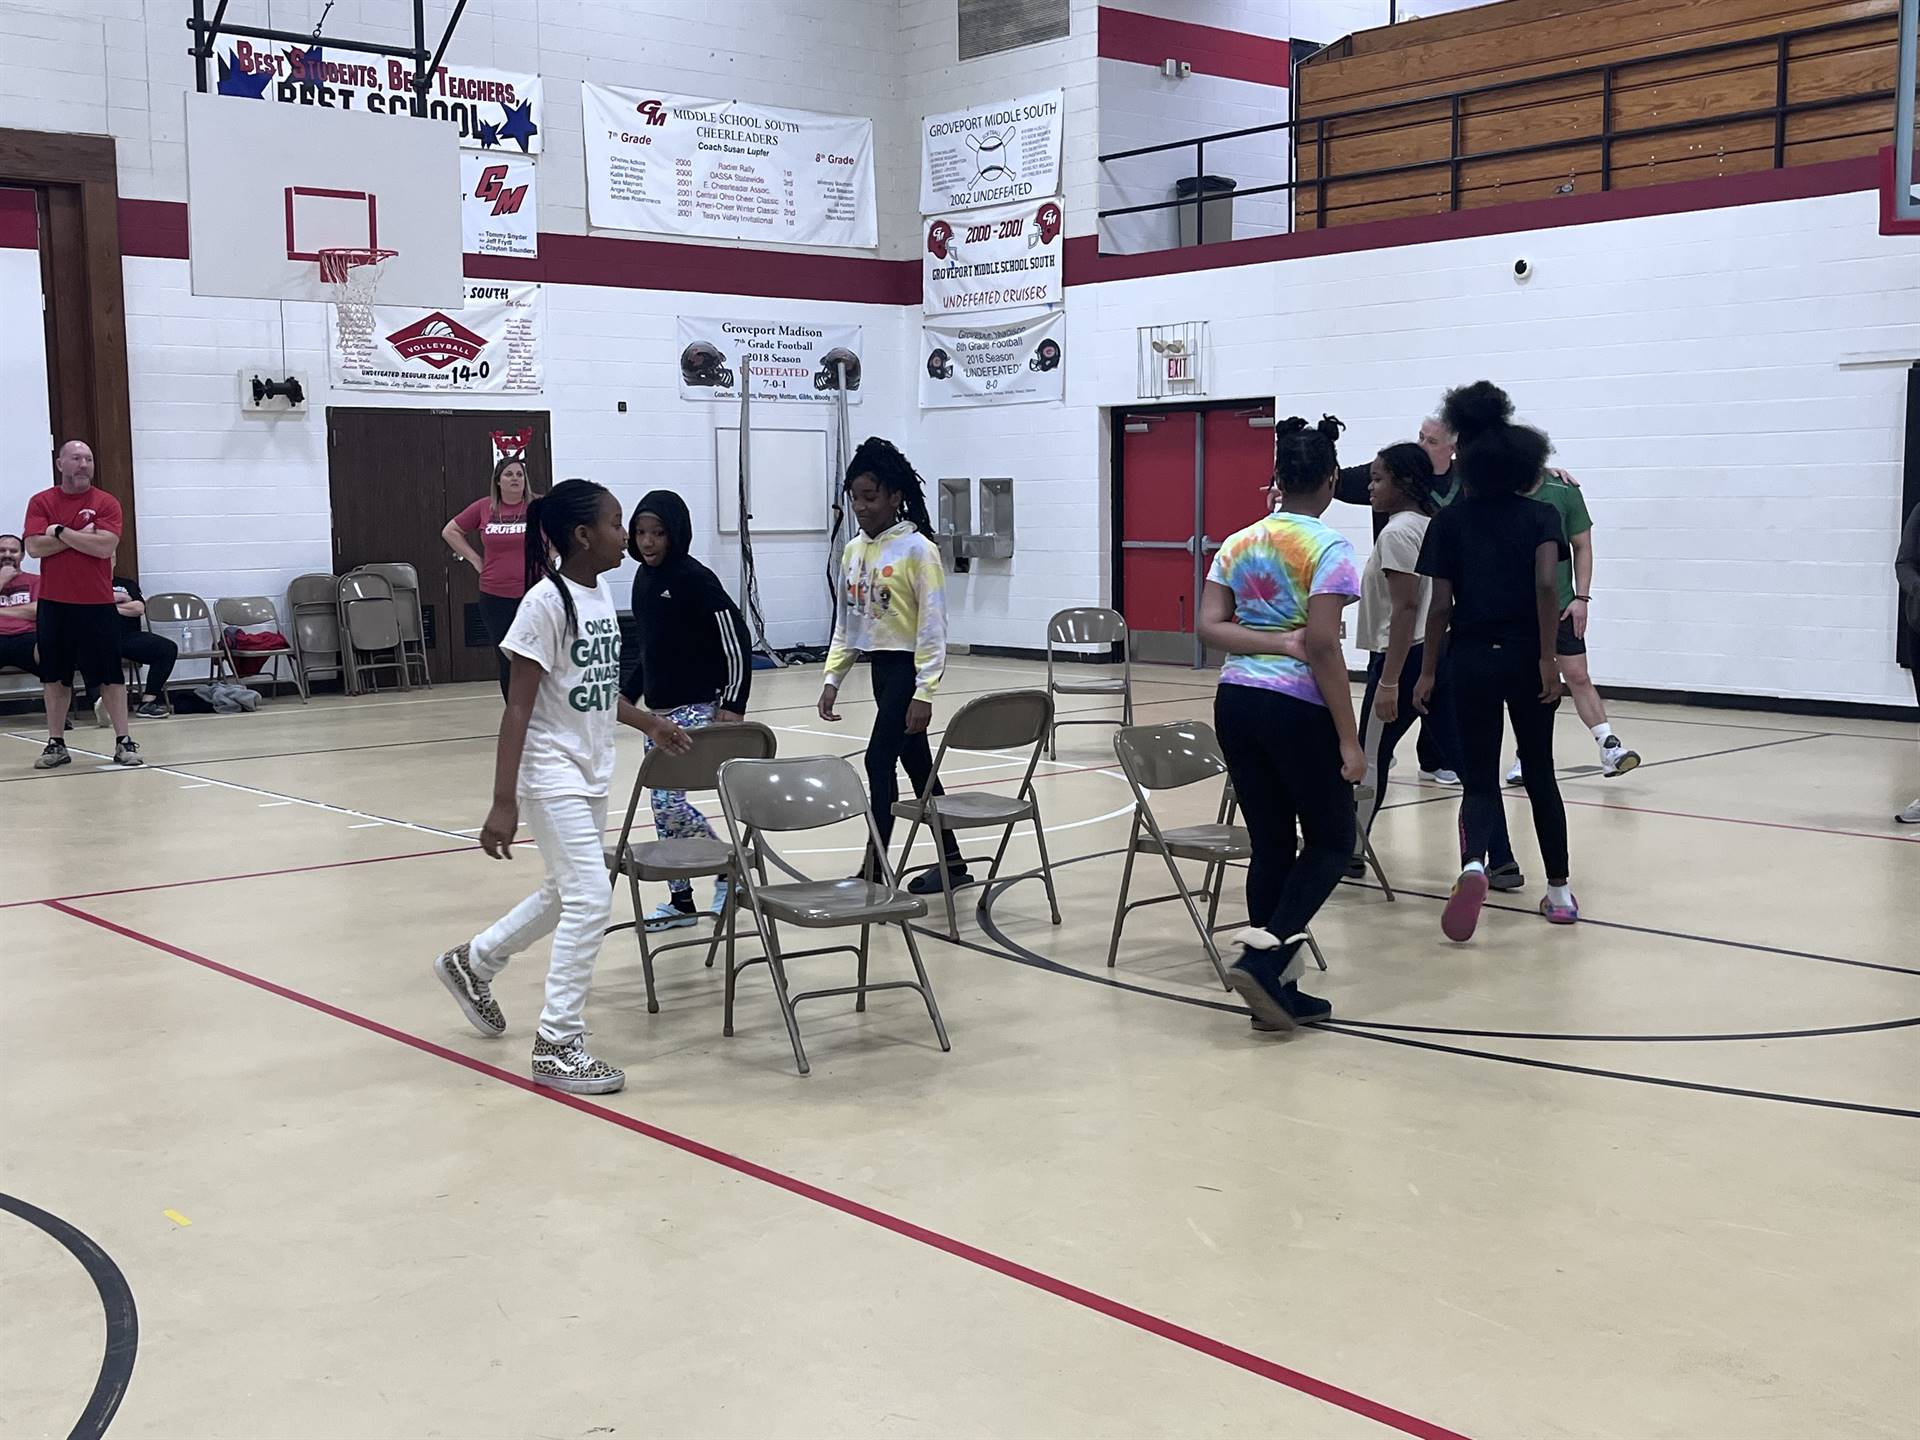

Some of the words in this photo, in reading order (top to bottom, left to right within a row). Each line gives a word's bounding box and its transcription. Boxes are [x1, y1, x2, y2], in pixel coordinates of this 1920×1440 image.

[367, 92, 483, 140] SCOOL
[637, 99, 667, 127] GM
[673, 109, 716, 123] MIDDLE
[719, 113, 761, 128] SCHOOL
[765, 117, 799, 133] SOUTH
[929, 116, 983, 137] GROVEPORT
[985, 109, 1021, 128] MIDDLE
[1024, 102, 1057, 120] SOUTH
[607, 130, 618, 140] 7th
[620, 132, 652, 145] Grade
[696, 126, 778, 146] CHEERLEADERS
[698, 142, 722, 153] Coach
[723, 145, 745, 155] Susan
[747, 147, 770, 158] Lupfer
[675, 158, 692, 168] 2000
[815, 153, 826, 164] 8th
[827, 154, 855, 165] Grade
[676, 168, 693, 178] 2000
[710, 171, 733, 181] OASSA
[475, 165, 529, 216] GM
[676, 178, 693, 188] 2001
[711, 181, 748, 192] Cheerleader
[677, 188, 693, 198] 2001
[696, 190, 718, 200] Central
[719, 192, 735, 201] Ohio
[756, 196, 779, 205] Classic
[950, 192, 972, 206] 2002
[973, 182, 1032, 203] UNDEFEATED
[677, 198, 693, 208] 2001
[696, 201, 735, 211] Ameri-Cheer
[736, 204, 755, 213] Winter
[756, 206, 779, 215] Classic
[677, 208, 693, 218] 2001
[722, 213, 740, 223] Valley
[740, 215, 773, 225] Invitational
[486, 231, 506, 239] Tommy
[507, 232, 528, 241] Snyder
[932, 264, 973, 281] GROVEPORT
[974, 263, 1000, 276] MIDDLE
[1000, 259, 1029, 273] SCHOOL
[1030, 255, 1055, 269] SOUTH
[470, 287, 508, 299] SOUTH
[943, 290, 1000, 309] UNDEFEATED
[1003, 285, 1047, 303] CRUISERS
[722, 322, 777, 338] Groveport
[779, 325, 823, 337] Madison
[407, 342, 471, 356] VOLLEYBALL
[734, 339, 746, 347] 7th
[747, 339, 775, 349] Grade
[777, 341, 813, 351] Football
[992, 337, 1023, 349] Football
[747, 352, 770, 363] 2018
[772, 353, 801, 364] Season
[967, 355, 984, 365] 2016
[985, 352, 1015, 363] Season
[361, 369, 401, 379] UNDEFEATED
[401, 371, 427, 380] REGULAR
[428, 371, 450, 381] SEASON
[451, 361, 490, 384] 14-0
[1168, 358, 1188, 378] EXIT
[763, 380, 786, 389] 7-0-1
[985, 380, 998, 390] 8-0
[585, 618, 612, 635] ONCE
[570, 634, 621, 667] GATO
[581, 664, 620, 684] ALWAS
[569, 683, 614, 712] GAT
